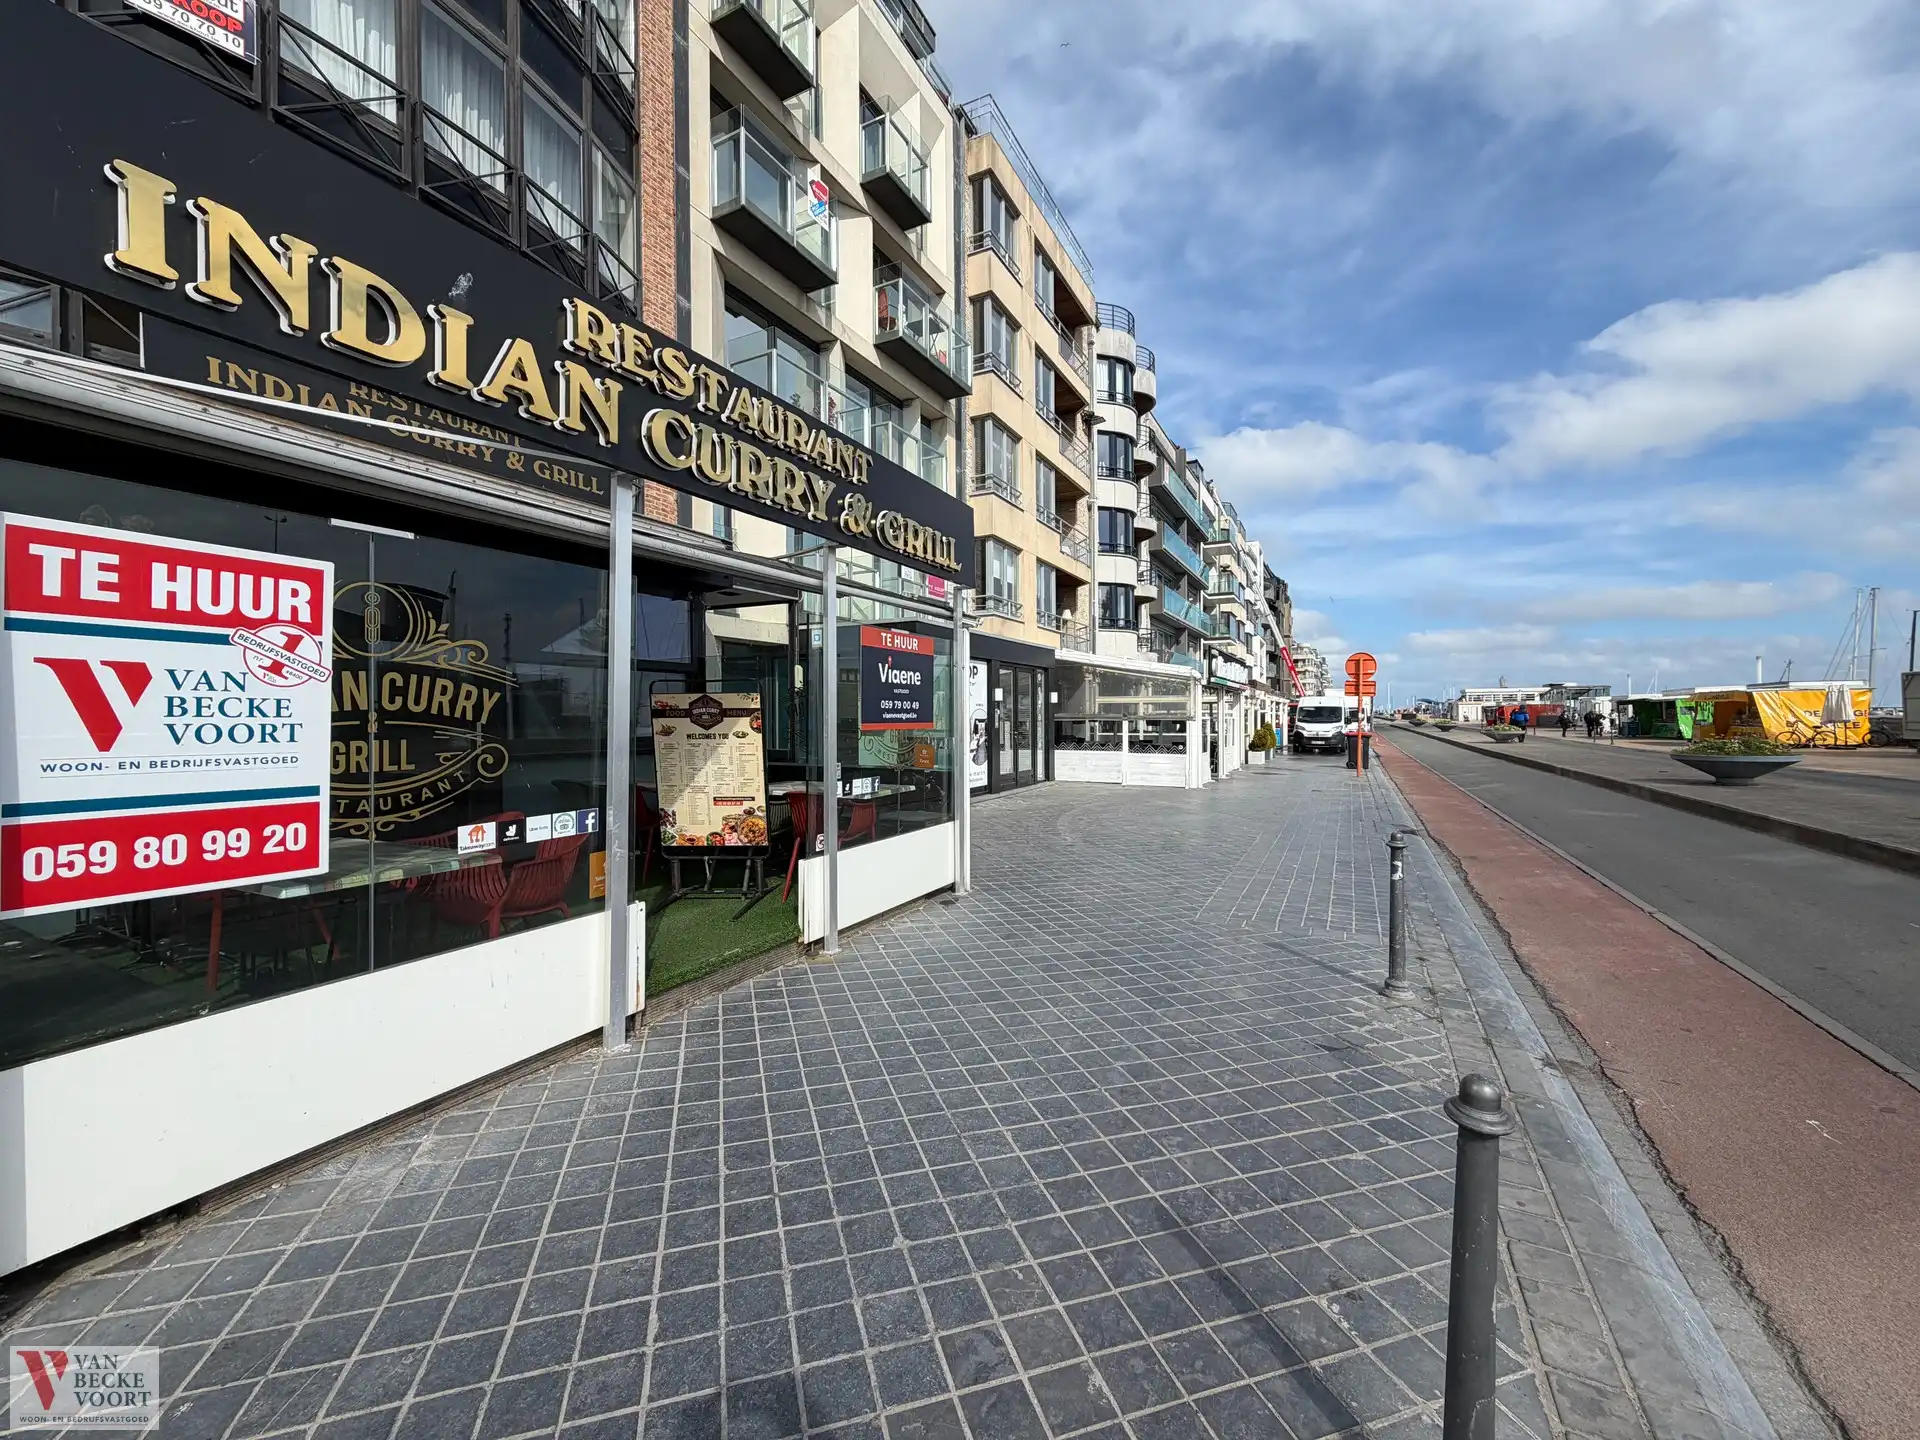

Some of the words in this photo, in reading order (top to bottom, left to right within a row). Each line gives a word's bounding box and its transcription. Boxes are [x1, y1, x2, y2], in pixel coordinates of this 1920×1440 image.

[169, 5, 190, 23] 70
[196, 18, 216, 36] 70
[222, 32, 241, 48] 10
[104, 158, 623, 448] INDIAN
[641, 407, 837, 524] CURRY
[840, 492, 874, 540] &
[876, 509, 963, 574] GRILL
[562, 297, 875, 485] RESTAURANT
[205, 355, 373, 428] INDIAN
[388, 413, 496, 463] CURRY
[506, 450, 526, 473] &
[533, 459, 605, 496] GRILL
[347, 381, 523, 451] RESTAURANT
[28, 542, 121, 603] TE
[151, 562, 312, 624] HUUR
[237, 632, 327, 678] BEDRIJFSVASTGOED
[881, 632, 893, 647] TE
[894, 634, 919, 651] HUUR
[163, 668, 249, 693] VAN
[878, 657, 921, 685] Viaene
[163, 695, 293, 719] BECKE
[381, 671, 502, 724] CURRY
[726, 709, 746, 717] MENU
[880, 700, 893, 709] 059
[894, 700, 902, 709] 79
[903, 701, 911, 710] 00
[912, 701, 920, 710] 49
[163, 722, 303, 745] VOORT
[686, 732, 717, 740] WELCOMES
[717, 732, 729, 740] YOU
[40, 761, 110, 773] WOON-
[118, 760, 141, 770] EN
[149, 755, 299, 769] BEDRIJFSVASTGOED
[330, 739, 415, 775] GRILL
[22, 840, 118, 882] 059
[133, 833, 188, 869] 80
[202, 827, 251, 861] 99
[262, 822, 307, 855] 20
